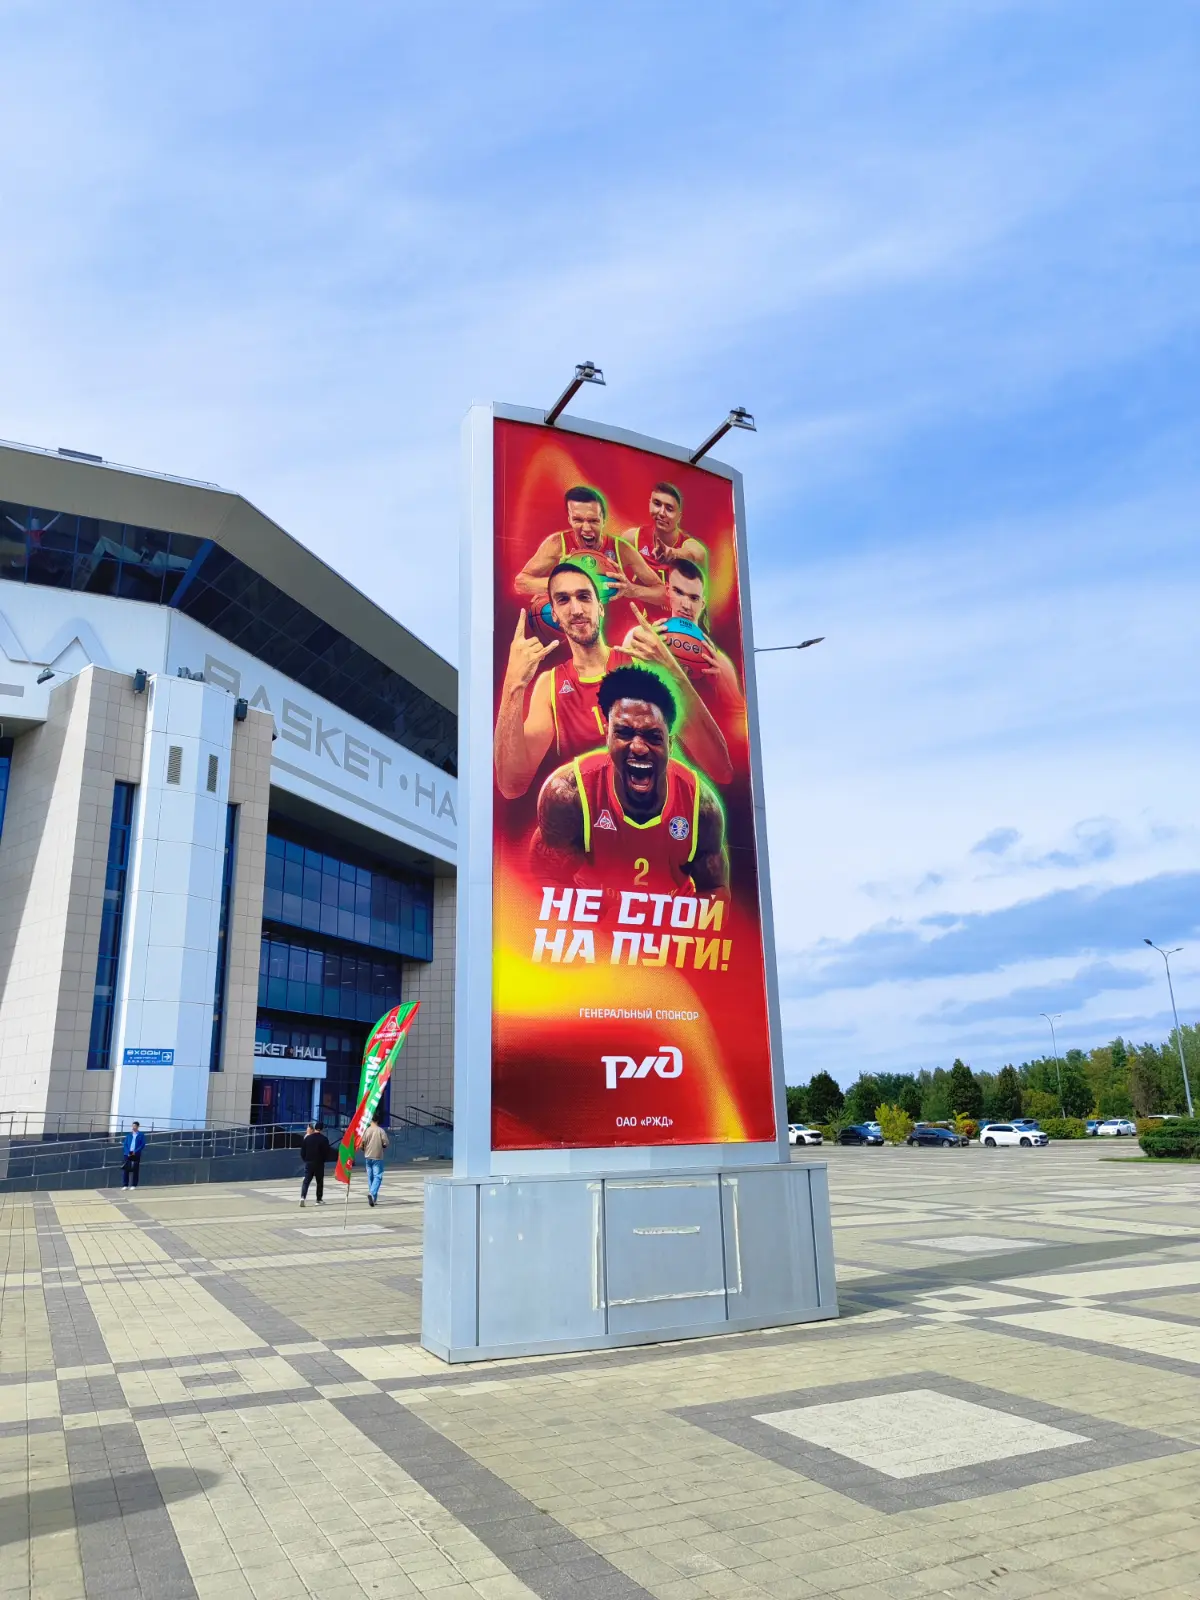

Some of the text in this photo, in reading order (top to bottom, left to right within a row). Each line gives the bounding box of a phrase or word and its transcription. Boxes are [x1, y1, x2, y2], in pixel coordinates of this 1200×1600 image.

[633, 857, 650, 886] 2
[538, 886, 603, 923] НЕ
[617, 890, 725, 932] СТОЙ
[531, 928, 732, 972] НА ПУТИ!
[579, 1007, 699, 1021] ГЕНЕРАЛЬНЫЙ СПОНСОР
[295, 1045, 327, 1060] HALL
[615, 1115, 674, 1128] ОАО «РЖД»
